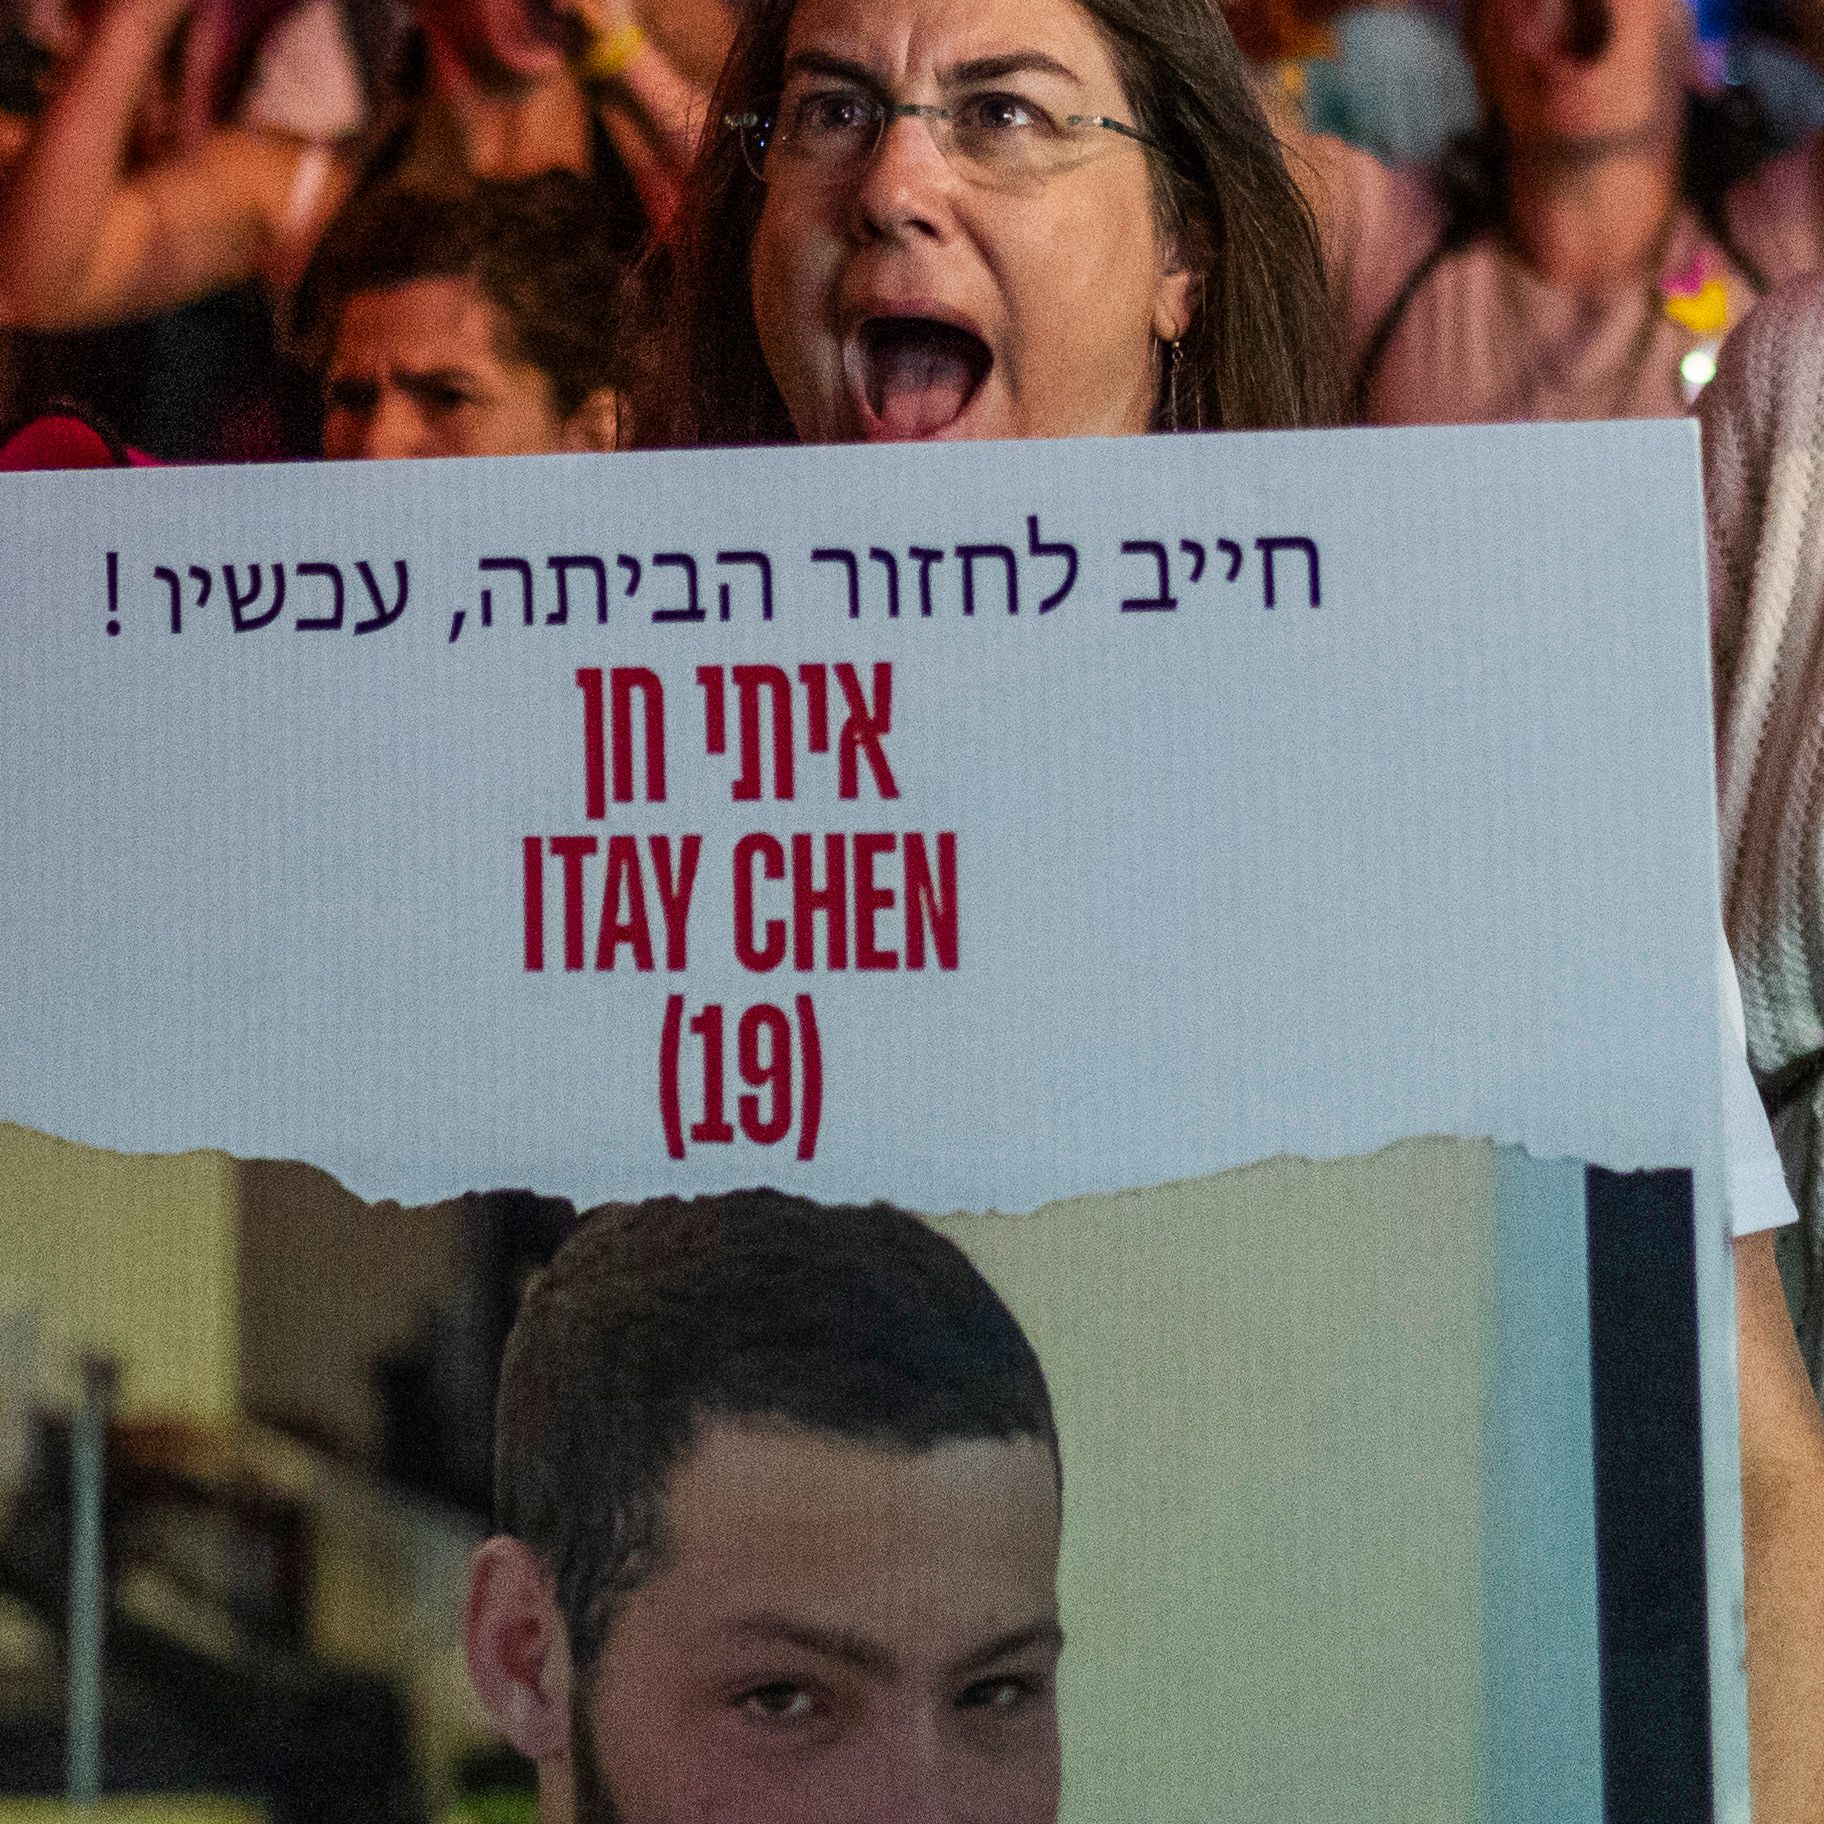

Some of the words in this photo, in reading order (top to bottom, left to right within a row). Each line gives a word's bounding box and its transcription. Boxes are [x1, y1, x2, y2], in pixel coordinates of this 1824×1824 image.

[153, 558, 410, 637] עכשיו
[447, 547, 774, 644] הביתה,
[810, 514, 1078, 620] לחזור
[1119, 533, 1322, 613] חייב
[575, 665, 667, 821] חן
[695, 661, 901, 801] איתי
[521, 832, 704, 973] ITAY
[732, 830, 961, 975] CHEN
[658, 992, 824, 1162] (19)
